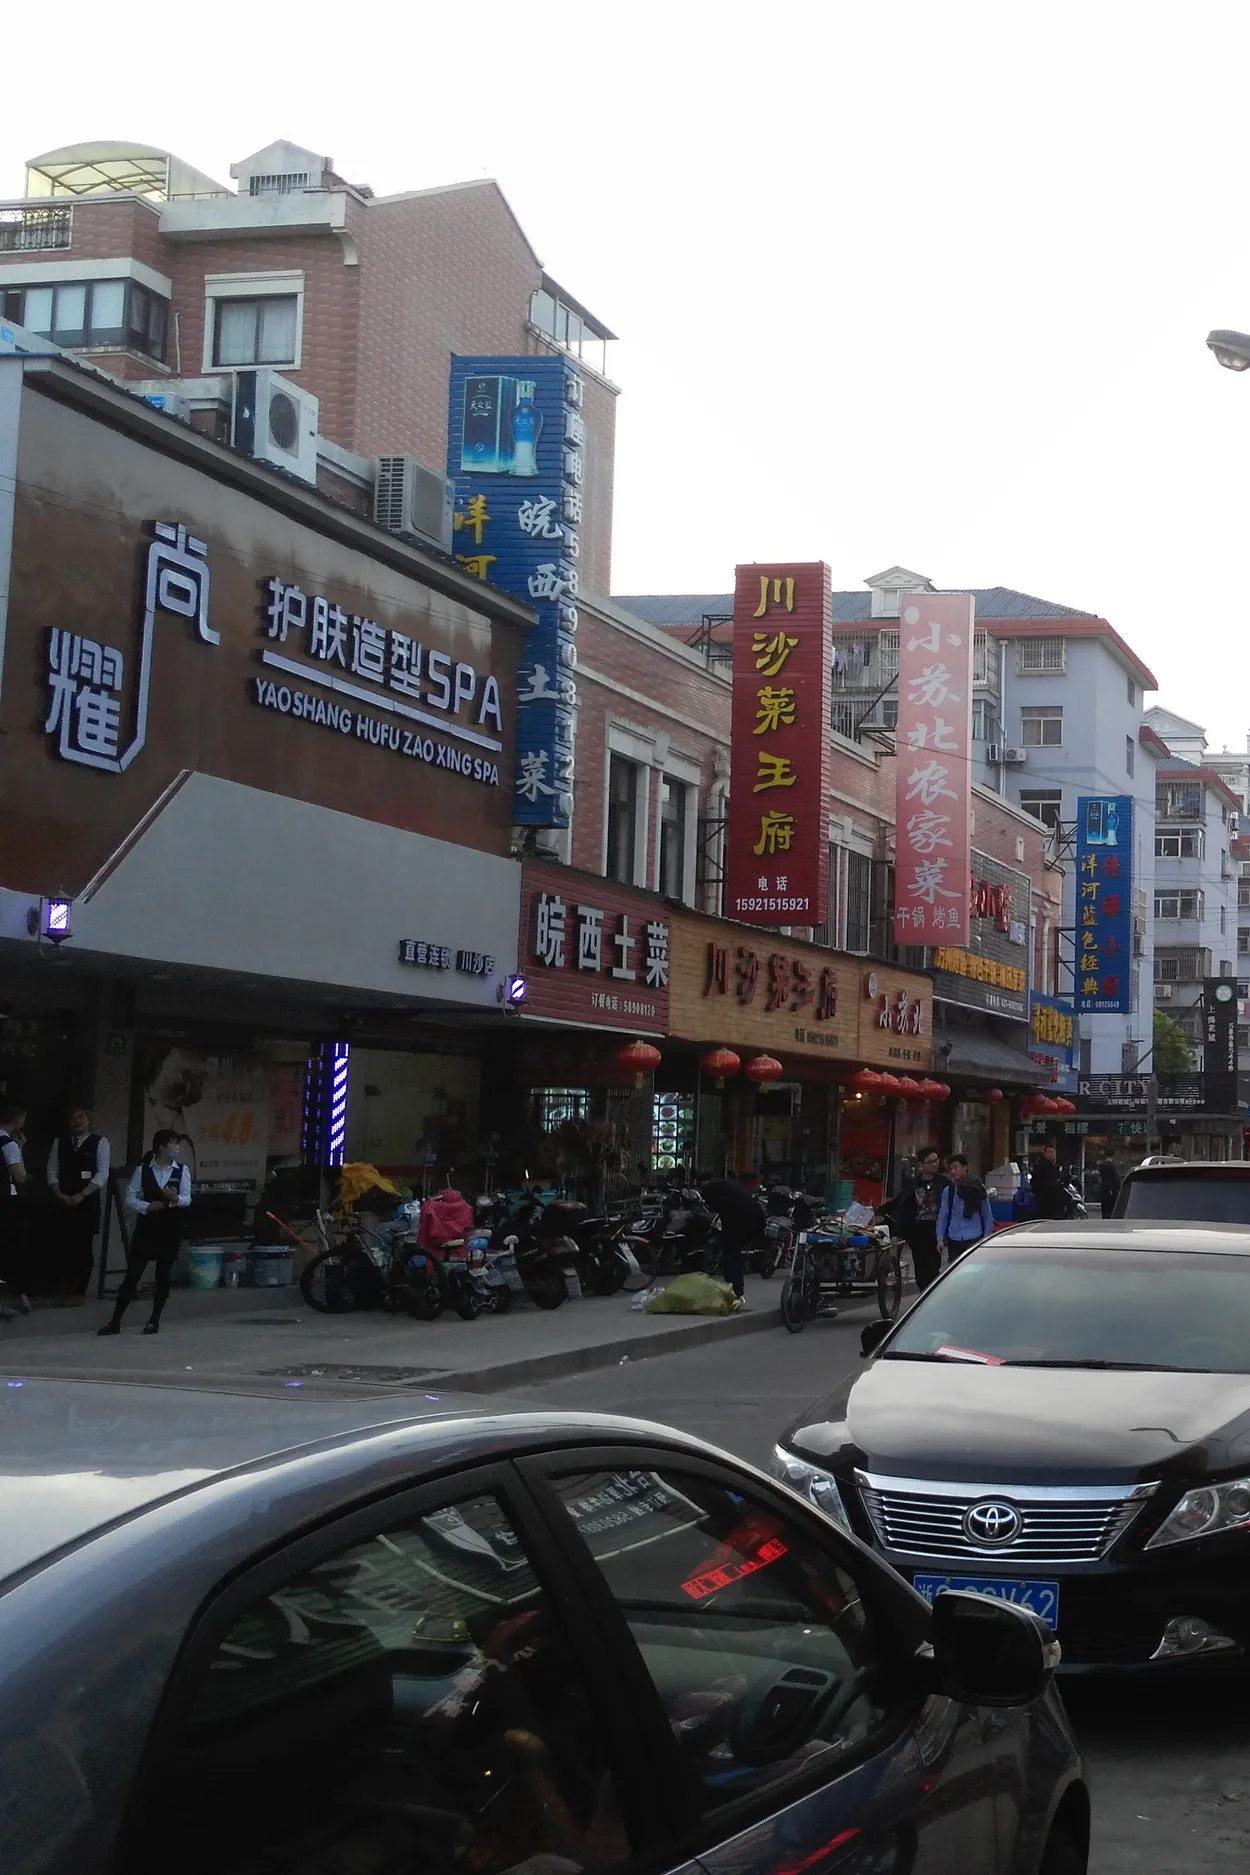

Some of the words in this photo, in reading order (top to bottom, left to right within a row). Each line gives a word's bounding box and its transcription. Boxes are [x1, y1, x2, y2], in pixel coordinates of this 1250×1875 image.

[268, 576, 503, 731] 护肤造型SPA
[516, 495, 566, 802] 皖西土菜
[357, 714, 400, 750] HUFU
[752, 576, 799, 857] 川沙菜王府
[905, 621, 964, 903] 小苏北农家菜
[758, 875, 788, 892] 电话
[735, 897, 810, 913] 15921515921
[897, 906, 925, 930] 干锅
[932, 906, 962, 930] 烤鱼
[536, 893, 669, 988] 皖西土菜
[460, 951, 496, 976] 川沙店
[1099, 1080, 1151, 1095] CITY
